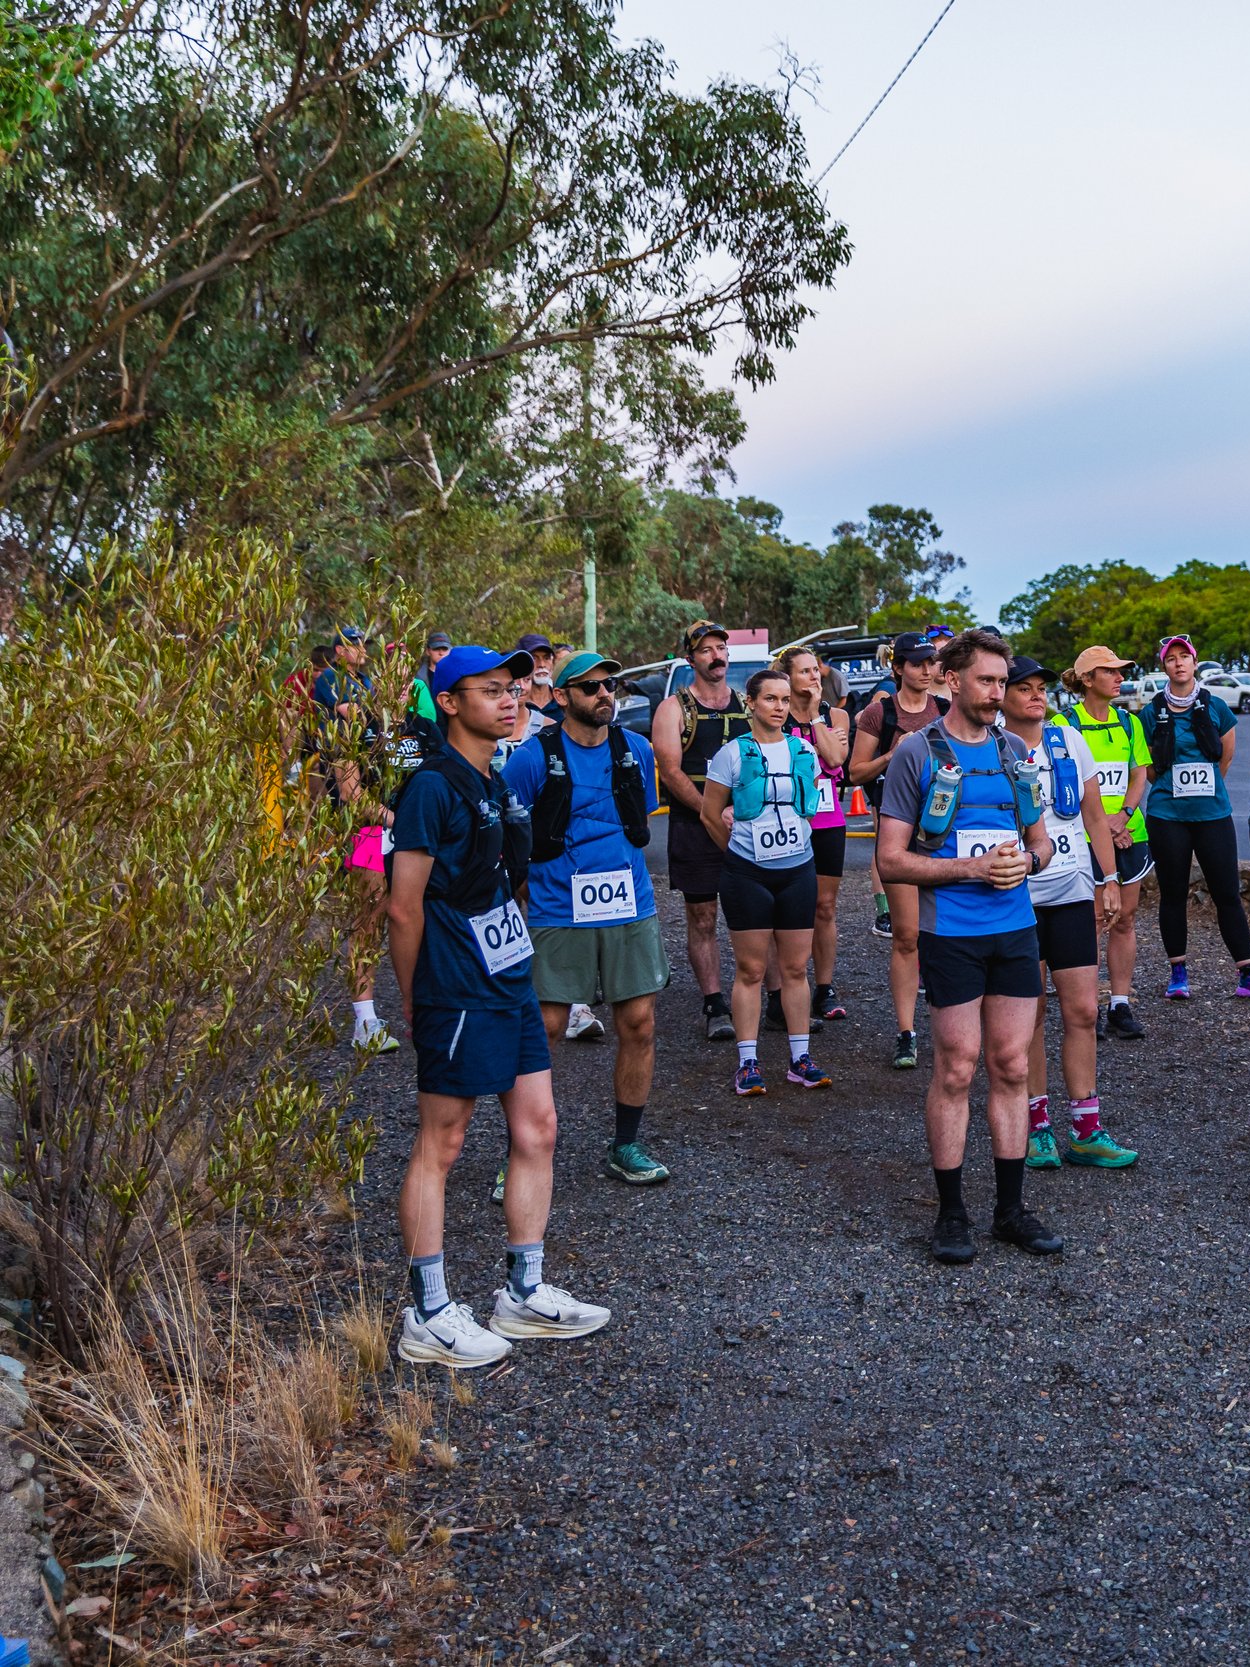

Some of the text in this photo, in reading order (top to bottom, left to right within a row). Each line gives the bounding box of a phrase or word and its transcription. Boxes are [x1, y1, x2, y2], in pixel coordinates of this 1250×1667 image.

[1096, 770, 1123, 786] 017
[1180, 769, 1208, 785] 012
[760, 827, 798, 848] 005
[580, 880, 628, 906] 004
[483, 912, 523, 950] 020
